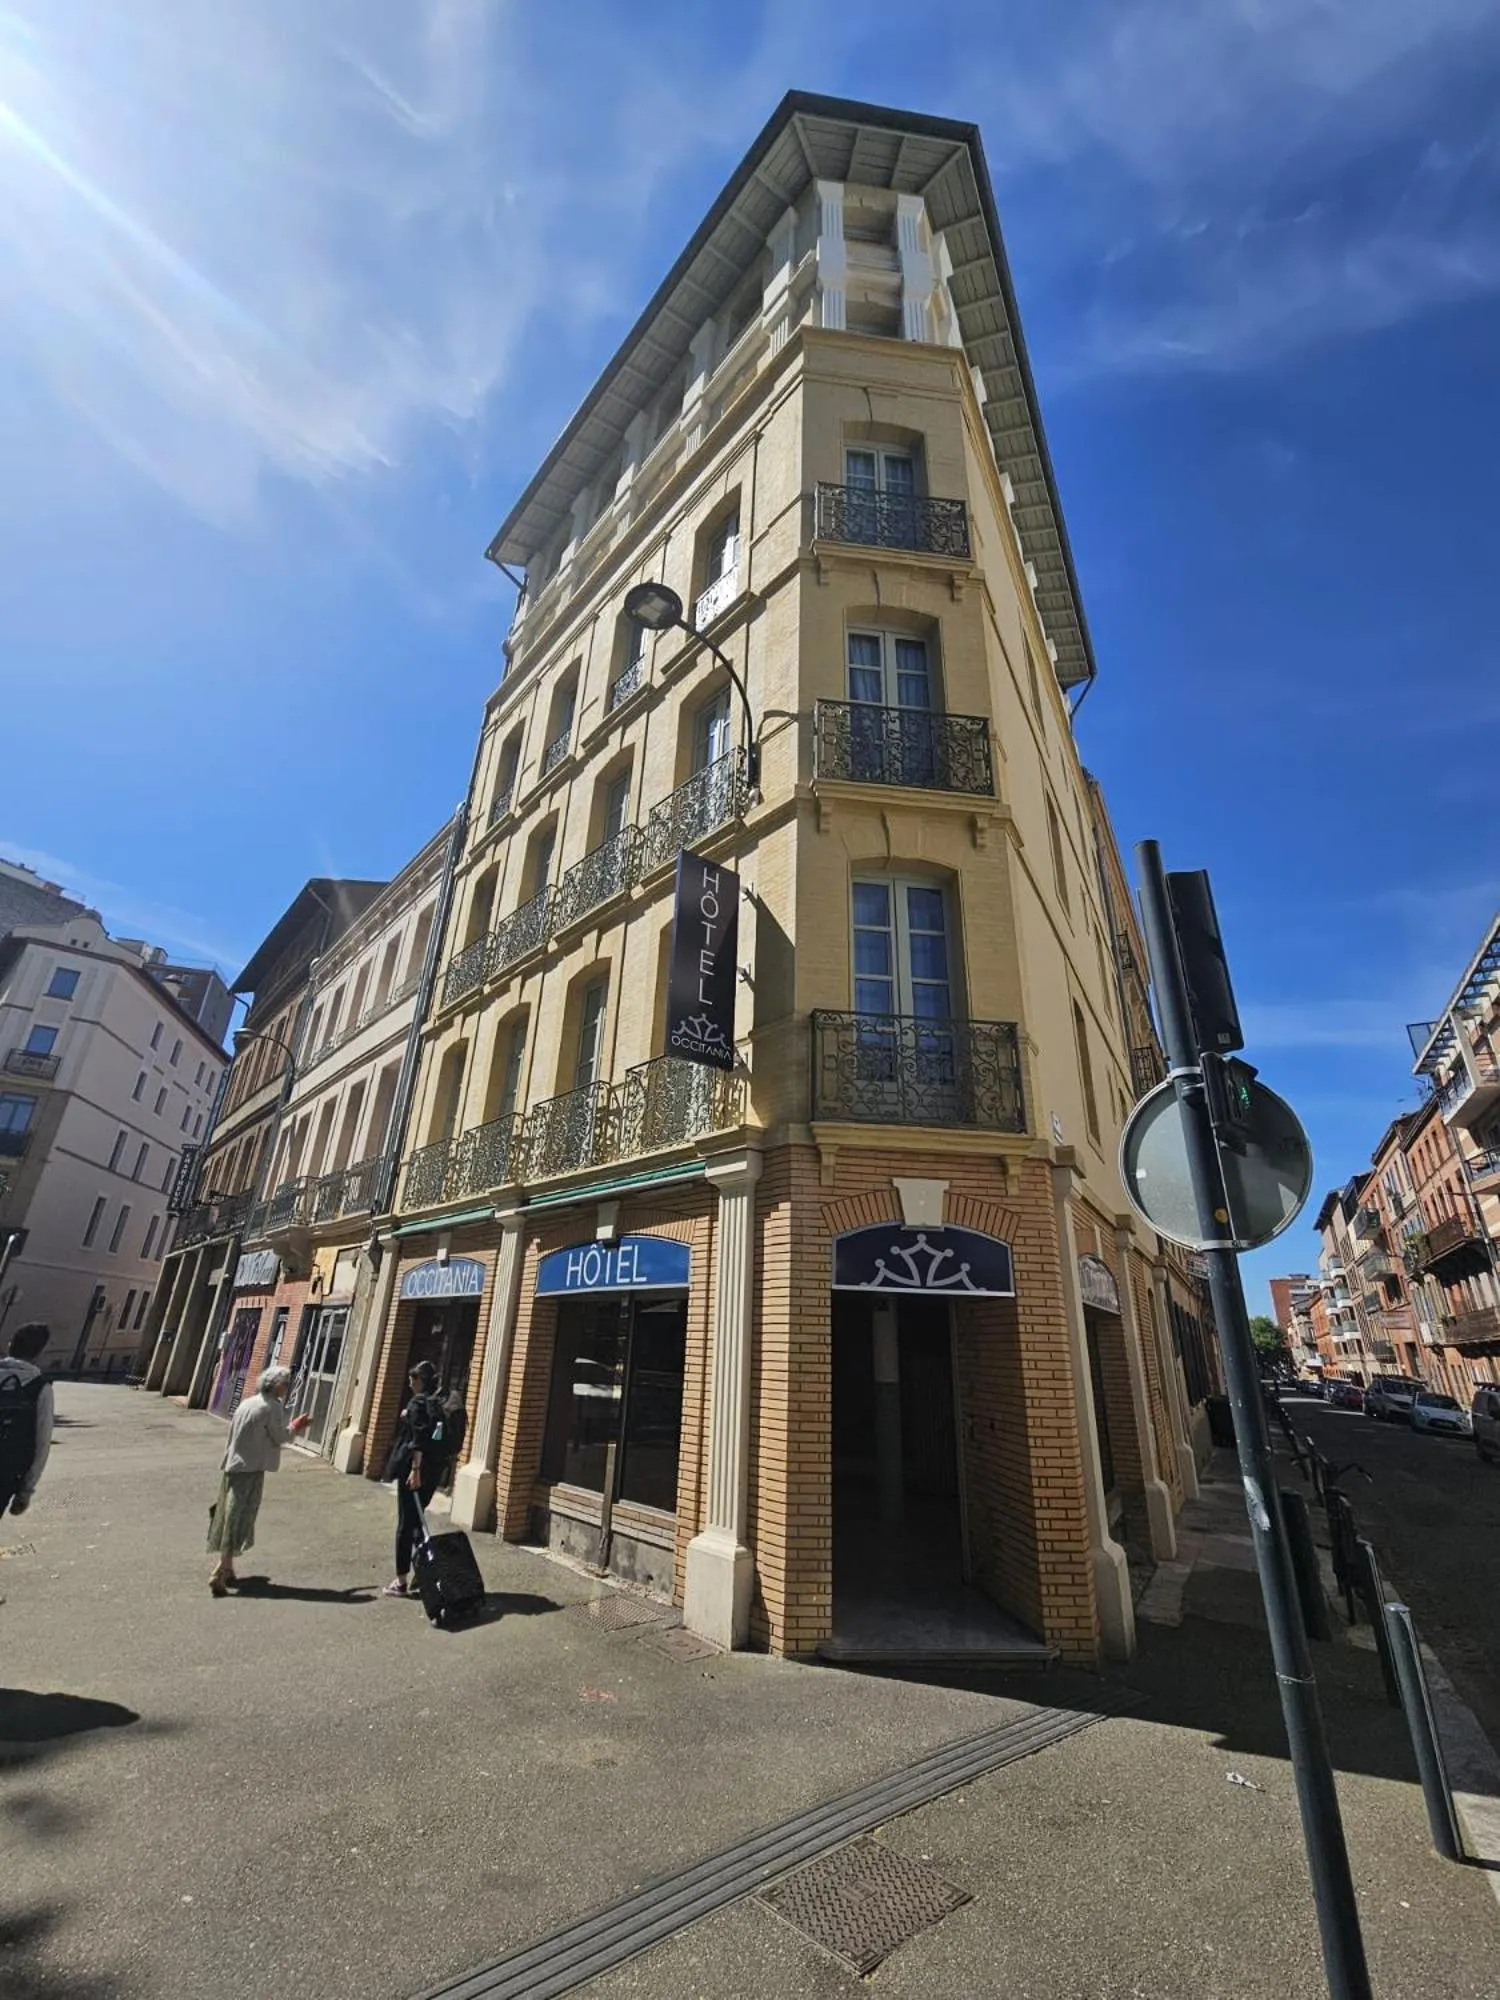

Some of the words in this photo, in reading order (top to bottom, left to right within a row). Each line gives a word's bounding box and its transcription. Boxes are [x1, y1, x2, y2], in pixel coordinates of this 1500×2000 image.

[698, 866, 720, 1005] HÔTEL
[671, 1035, 732, 1061] OCCITANIA
[407, 1264, 479, 1296] OCCITANIA
[566, 1244, 647, 1287] HÔTEL
